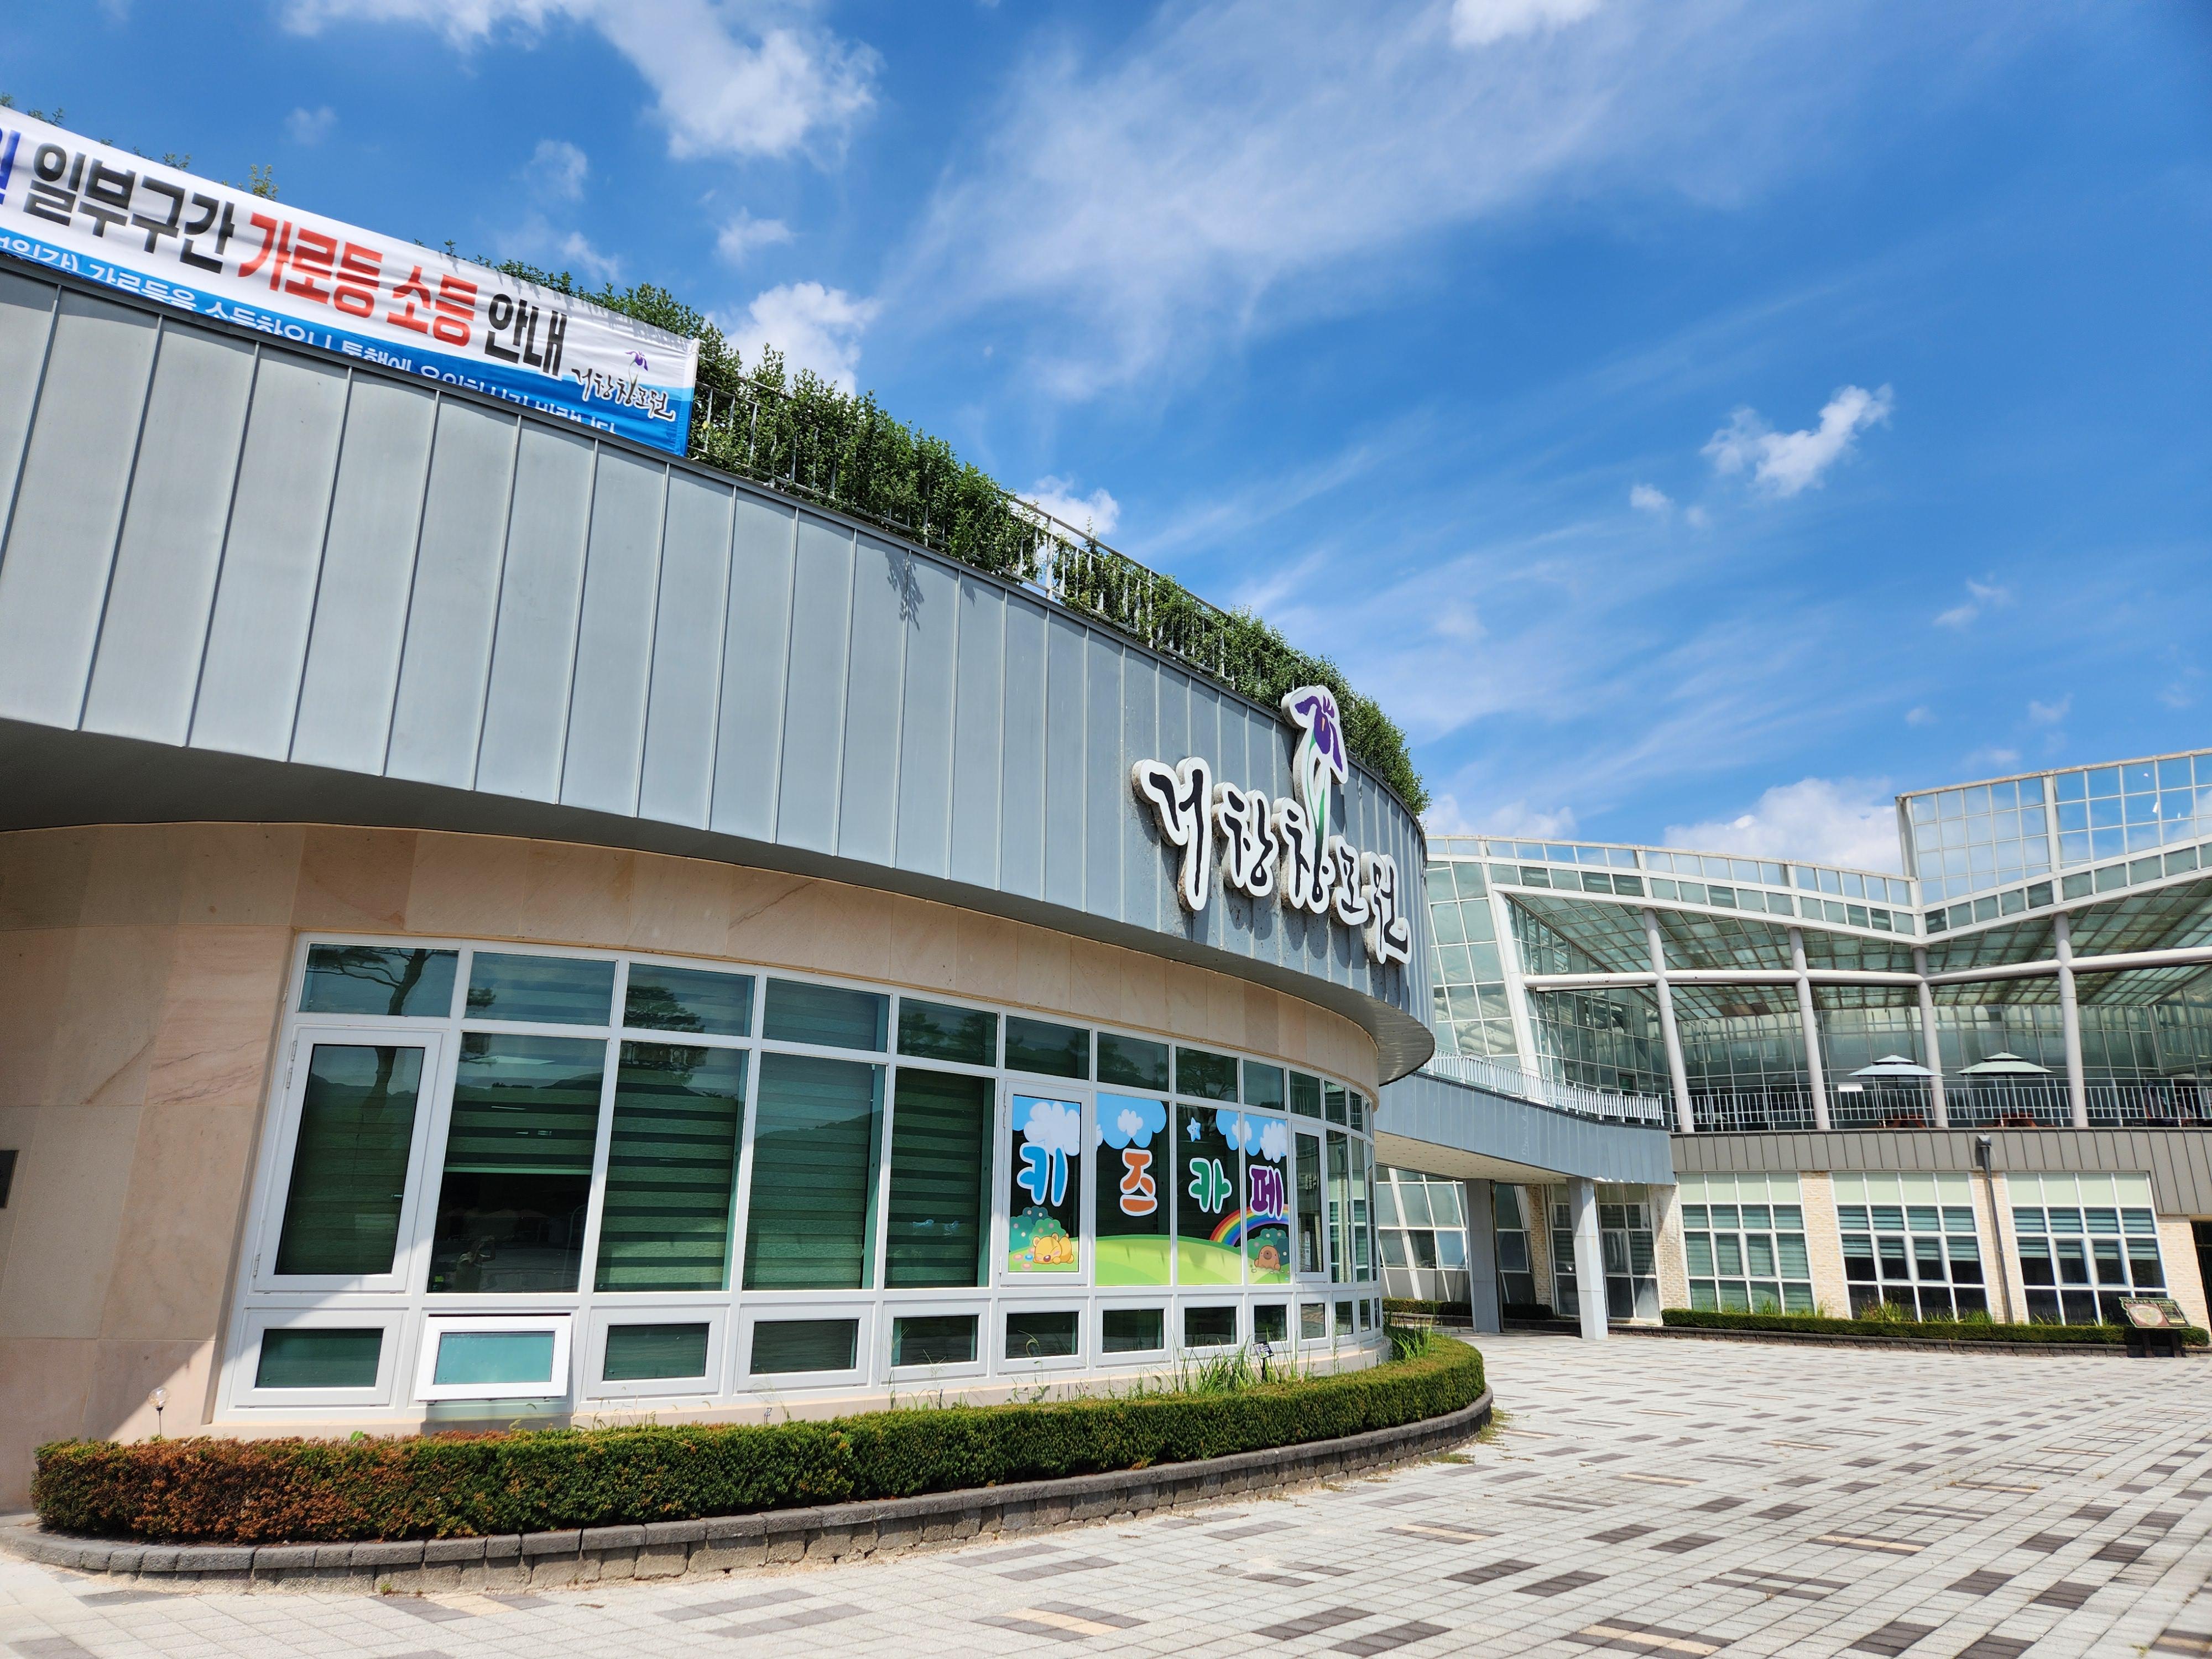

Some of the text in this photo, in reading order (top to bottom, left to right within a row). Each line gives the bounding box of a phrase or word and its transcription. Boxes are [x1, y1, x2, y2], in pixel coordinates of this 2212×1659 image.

[23, 142, 234, 274] 일부구간
[238, 212, 383, 319] 가로등
[387, 265, 478, 347] 소등
[484, 293, 567, 377] 안내
